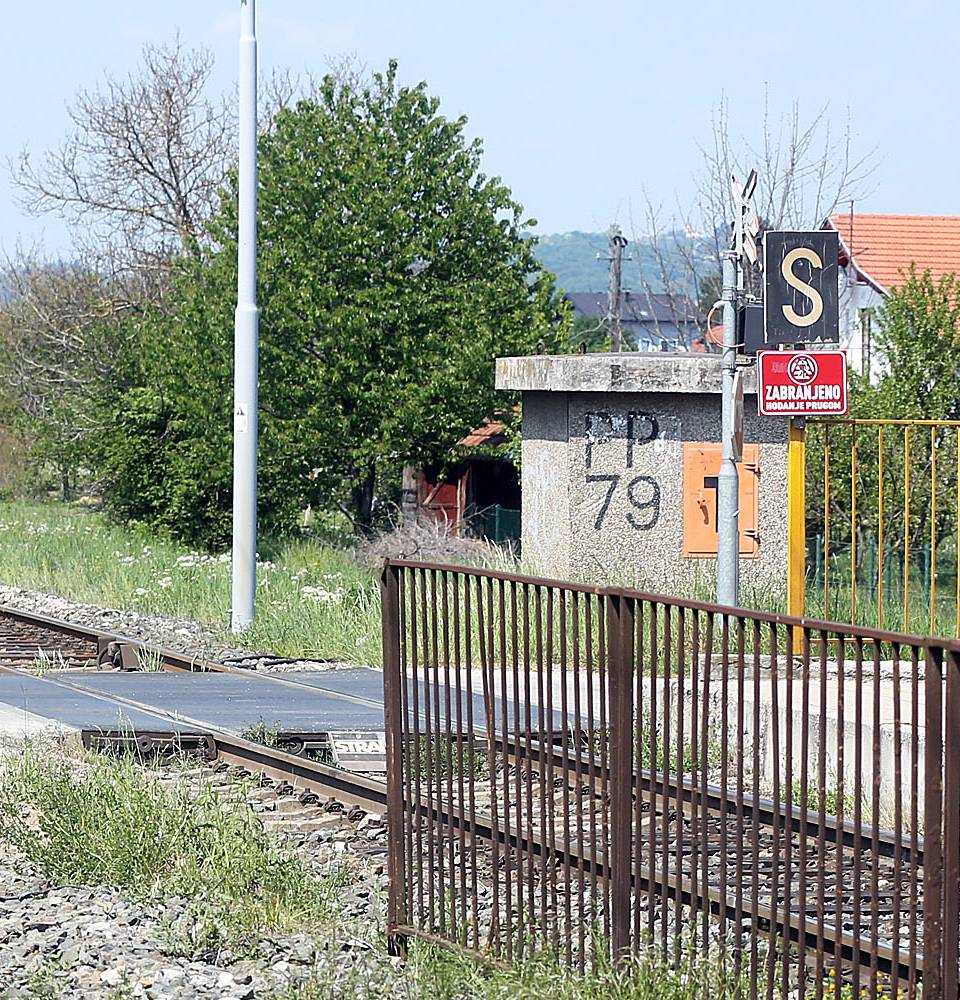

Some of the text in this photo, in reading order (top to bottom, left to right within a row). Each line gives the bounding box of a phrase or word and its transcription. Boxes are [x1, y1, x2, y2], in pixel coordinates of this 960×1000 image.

[782, 248, 823, 326] S
[765, 384, 841, 401] ZABRANJENO
[765, 401, 842, 411] HODANJE PRUGOM
[585, 474, 661, 530] 79
